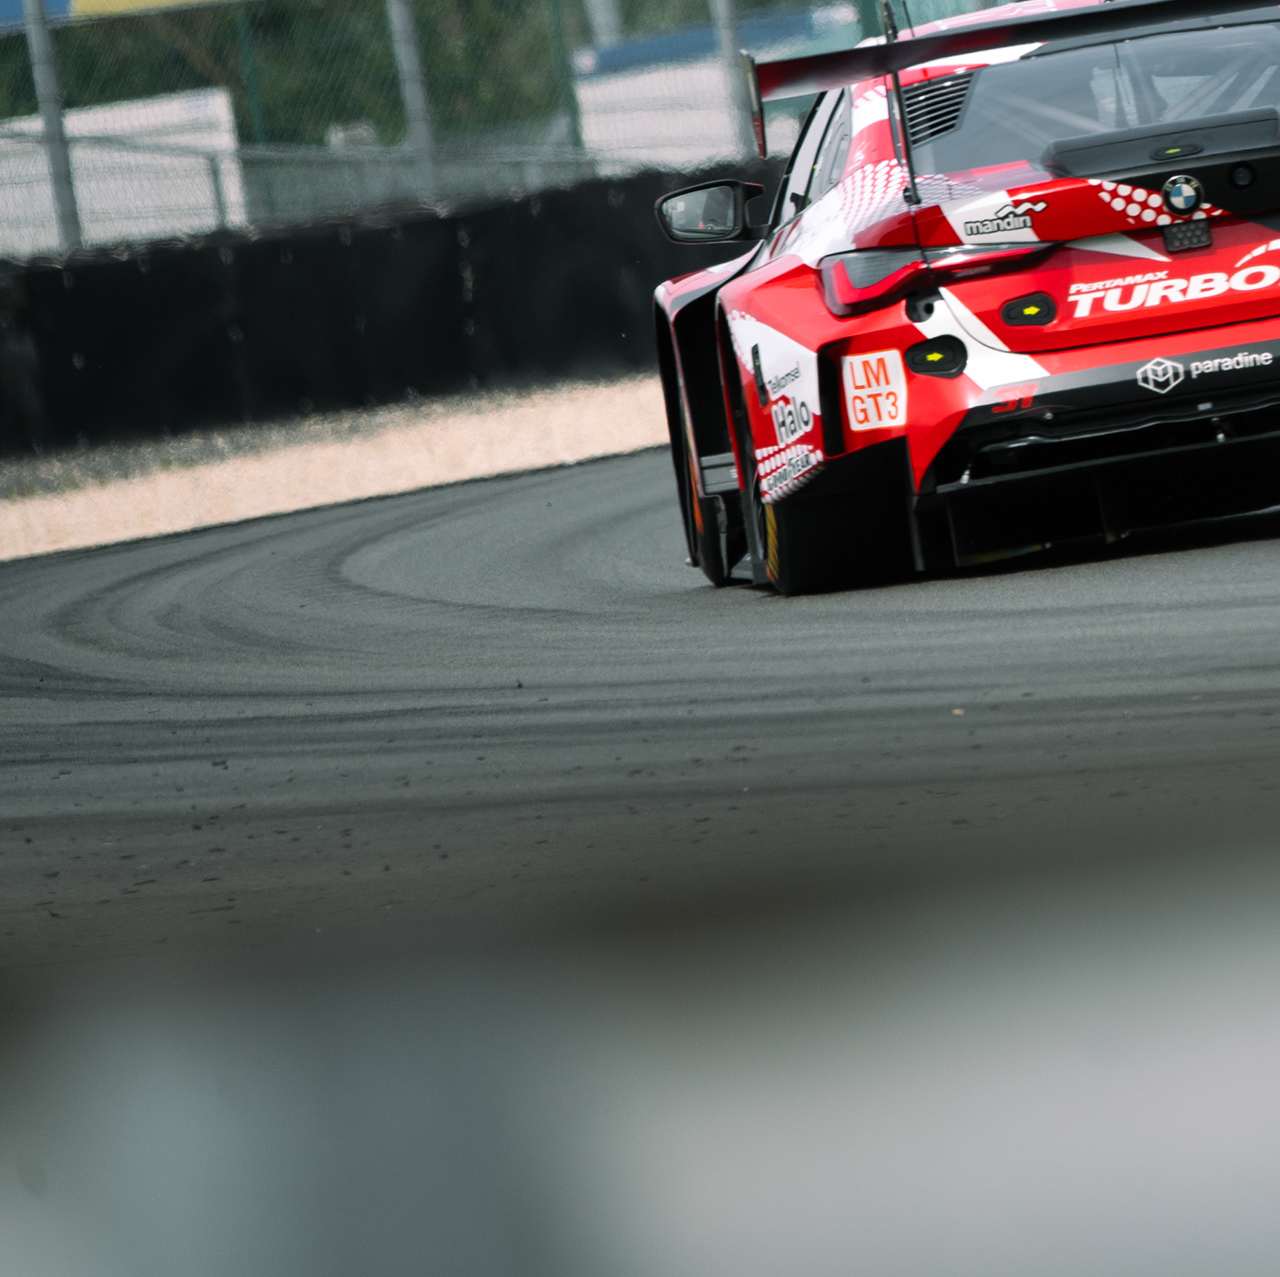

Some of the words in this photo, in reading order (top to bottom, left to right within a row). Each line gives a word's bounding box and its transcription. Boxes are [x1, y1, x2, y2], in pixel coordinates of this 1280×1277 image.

[1068, 270, 1170, 295] PERTAMAX
[767, 361, 802, 395] Telkomsel
[850, 357, 891, 391] LM
[1190, 351, 1273, 378] paradine
[773, 396, 812, 444] Halo
[852, 391, 899, 425] GT3
